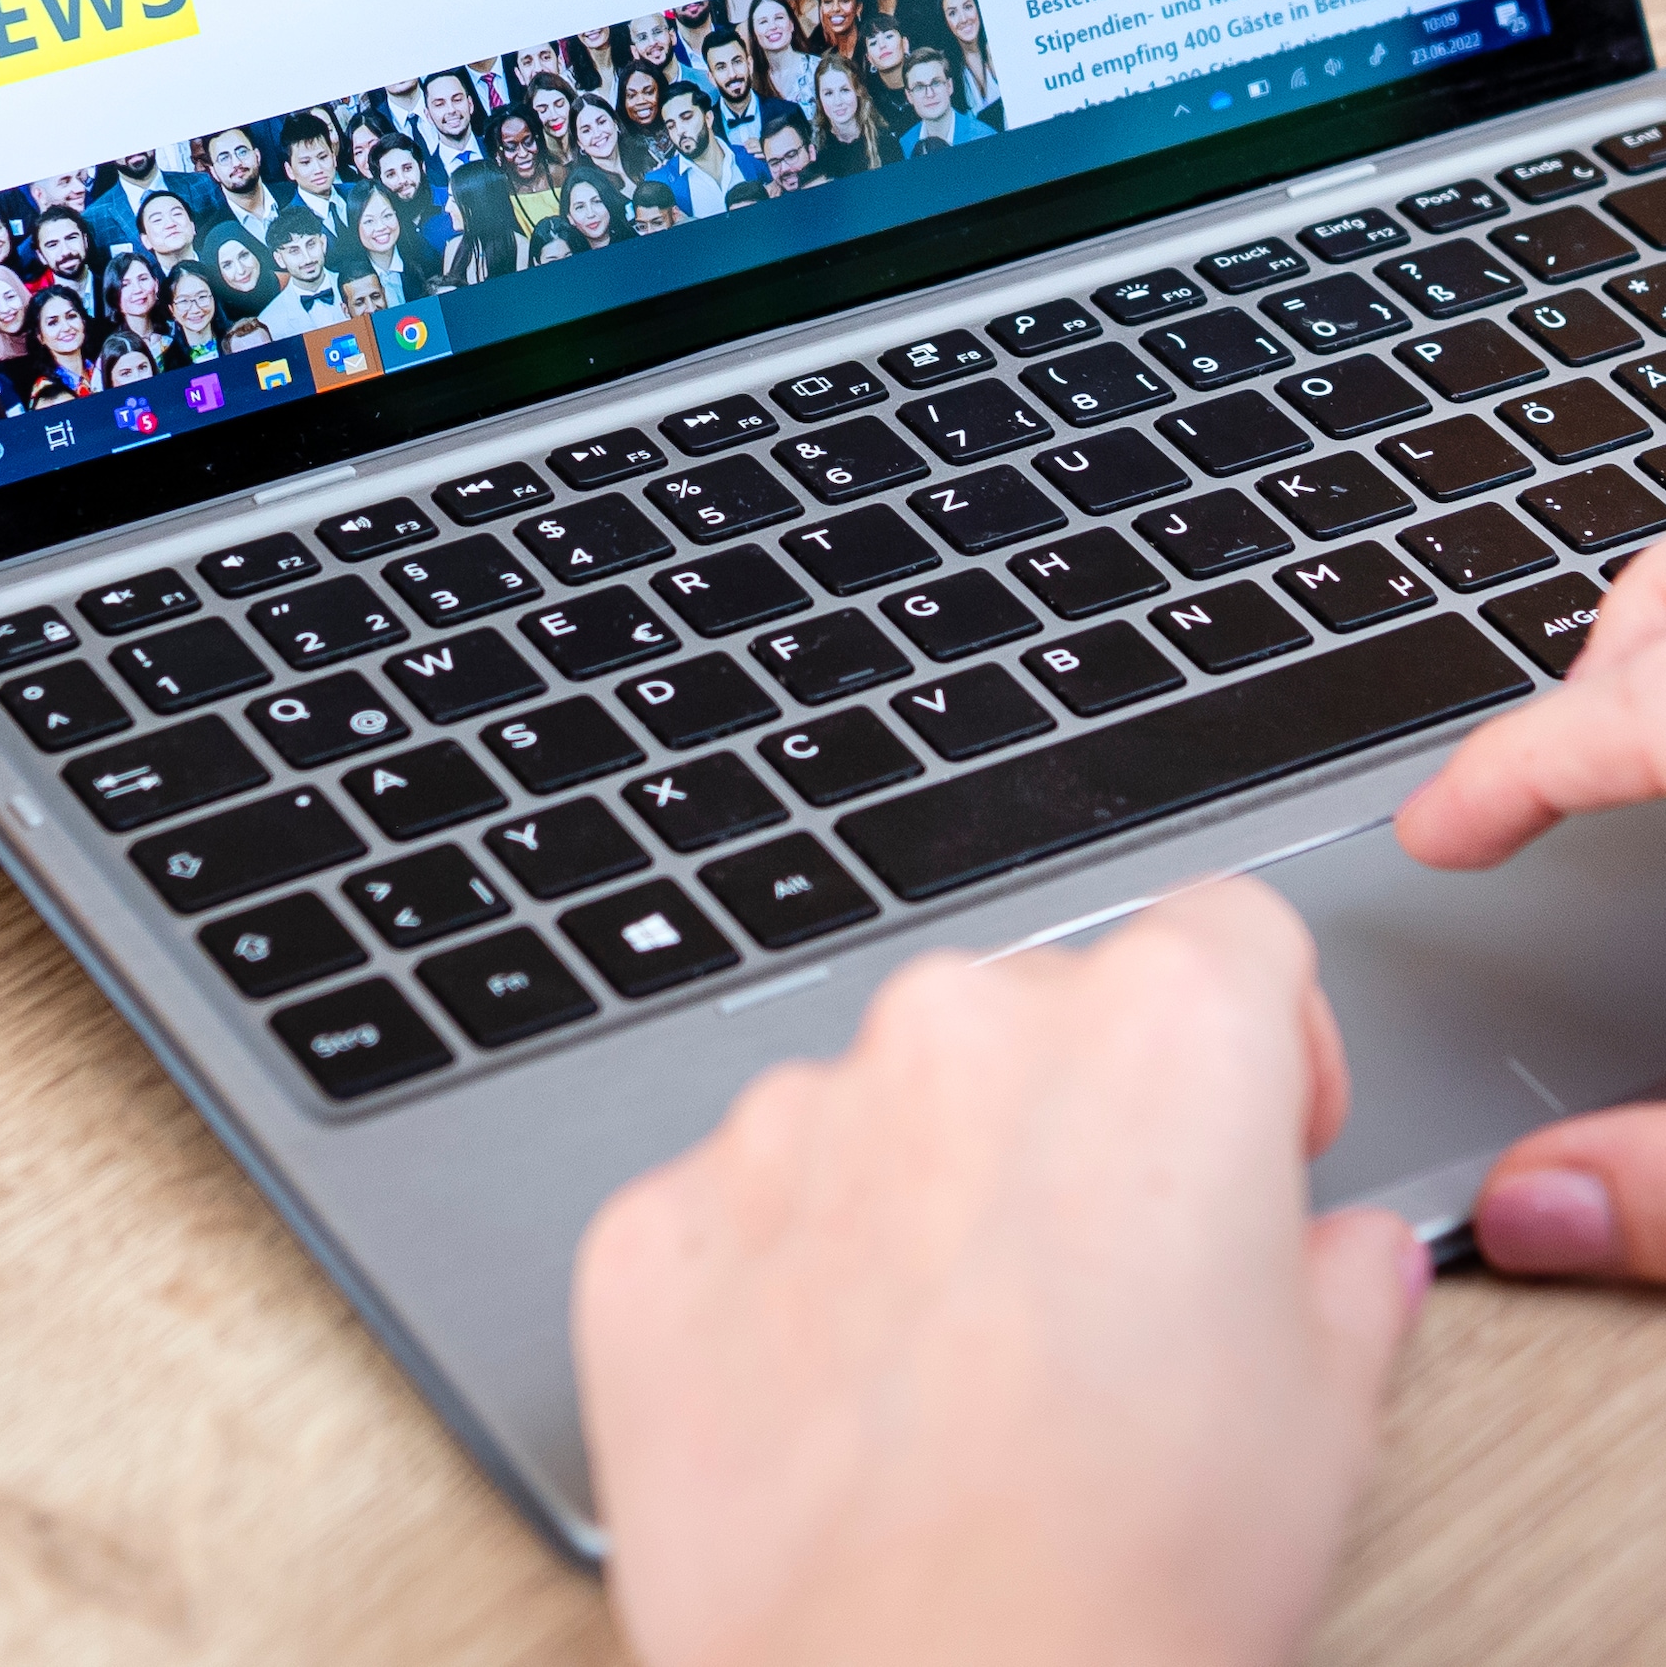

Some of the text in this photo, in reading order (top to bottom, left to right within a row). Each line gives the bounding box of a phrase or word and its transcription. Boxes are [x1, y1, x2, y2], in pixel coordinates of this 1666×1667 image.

[1035, 11, 1155, 55] Stipendien-
[1044, 62, 1085, 92] und
[1091, 40, 1179, 79] empfing
[1183, 25, 1222, 52] 400
[1227, 9, 1284, 40] Gäste
[1289, 3, 1309, 21] in
[1410, 32, 1481, 65] 23.06.2022
[1622, 127, 1662, 146] Entf
[1514, 158, 1564, 178] Ende
[1415, 188, 1461, 208] Pos1
[1314, 218, 1367, 238] Einfg
[1366, 227, 1397, 242] F12
[1213, 246, 1272, 268] Druck
[1268, 256, 1297, 271] F11
[1161, 287, 1193, 302] F10
[1426, 284, 1456, 303] ß
[1062, 319, 1087, 332] F9
[1533, 306, 1567, 329] Ü
[956, 350, 982, 364] F8
[1414, 342, 1443, 363] P
[1192, 356, 1219, 374] 9
[189, 390, 201, 402] N
[849, 382, 870, 396] F7
[1301, 377, 1334, 397] O
[1071, 393, 1099, 410] 8
[119, 410, 129, 422] T
[142, 416, 153, 428] 5
[737, 415, 763, 429] F6
[1521, 401, 1555, 424] Ö
[945, 429, 966, 448] 7
[626, 449, 652, 463] F5
[795, 442, 828, 460] &
[1053, 450, 1090, 472] U
[1398, 442, 1434, 460] L
[825, 467, 853, 485] 6
[1277, 474, 1317, 498] K
[512, 484, 538, 498] F4
[666, 478, 702, 499] %
[929, 489, 970, 513] Z
[697, 506, 726, 525] 5
[1164, 513, 1188, 535] J
[395, 520, 421, 535] F3
[537, 520, 566, 539] $
[801, 528, 832, 550] T
[277, 555, 305, 570] F2
[570, 547, 594, 565] 4
[1028, 551, 1071, 577] H
[671, 571, 711, 595] R
[1295, 563, 1341, 590] M
[160, 591, 186, 606] F1
[430, 590, 460, 610] 3
[904, 595, 940, 617] G
[539, 611, 578, 637] E
[1169, 604, 1213, 630] N
[295, 631, 326, 653] 2
[631, 622, 664, 643] €
[770, 635, 800, 661] F
[403, 647, 454, 677] W
[1042, 648, 1080, 673] B
[156, 676, 180, 695] 1
[636, 680, 675, 705] D
[268, 698, 311, 723] Q
[912, 688, 946, 713] V
[349, 709, 389, 735] @
[501, 722, 538, 749] S
[782, 734, 820, 759] C
[372, 768, 408, 795] A
[643, 777, 687, 807] X
[504, 822, 539, 851] Y
